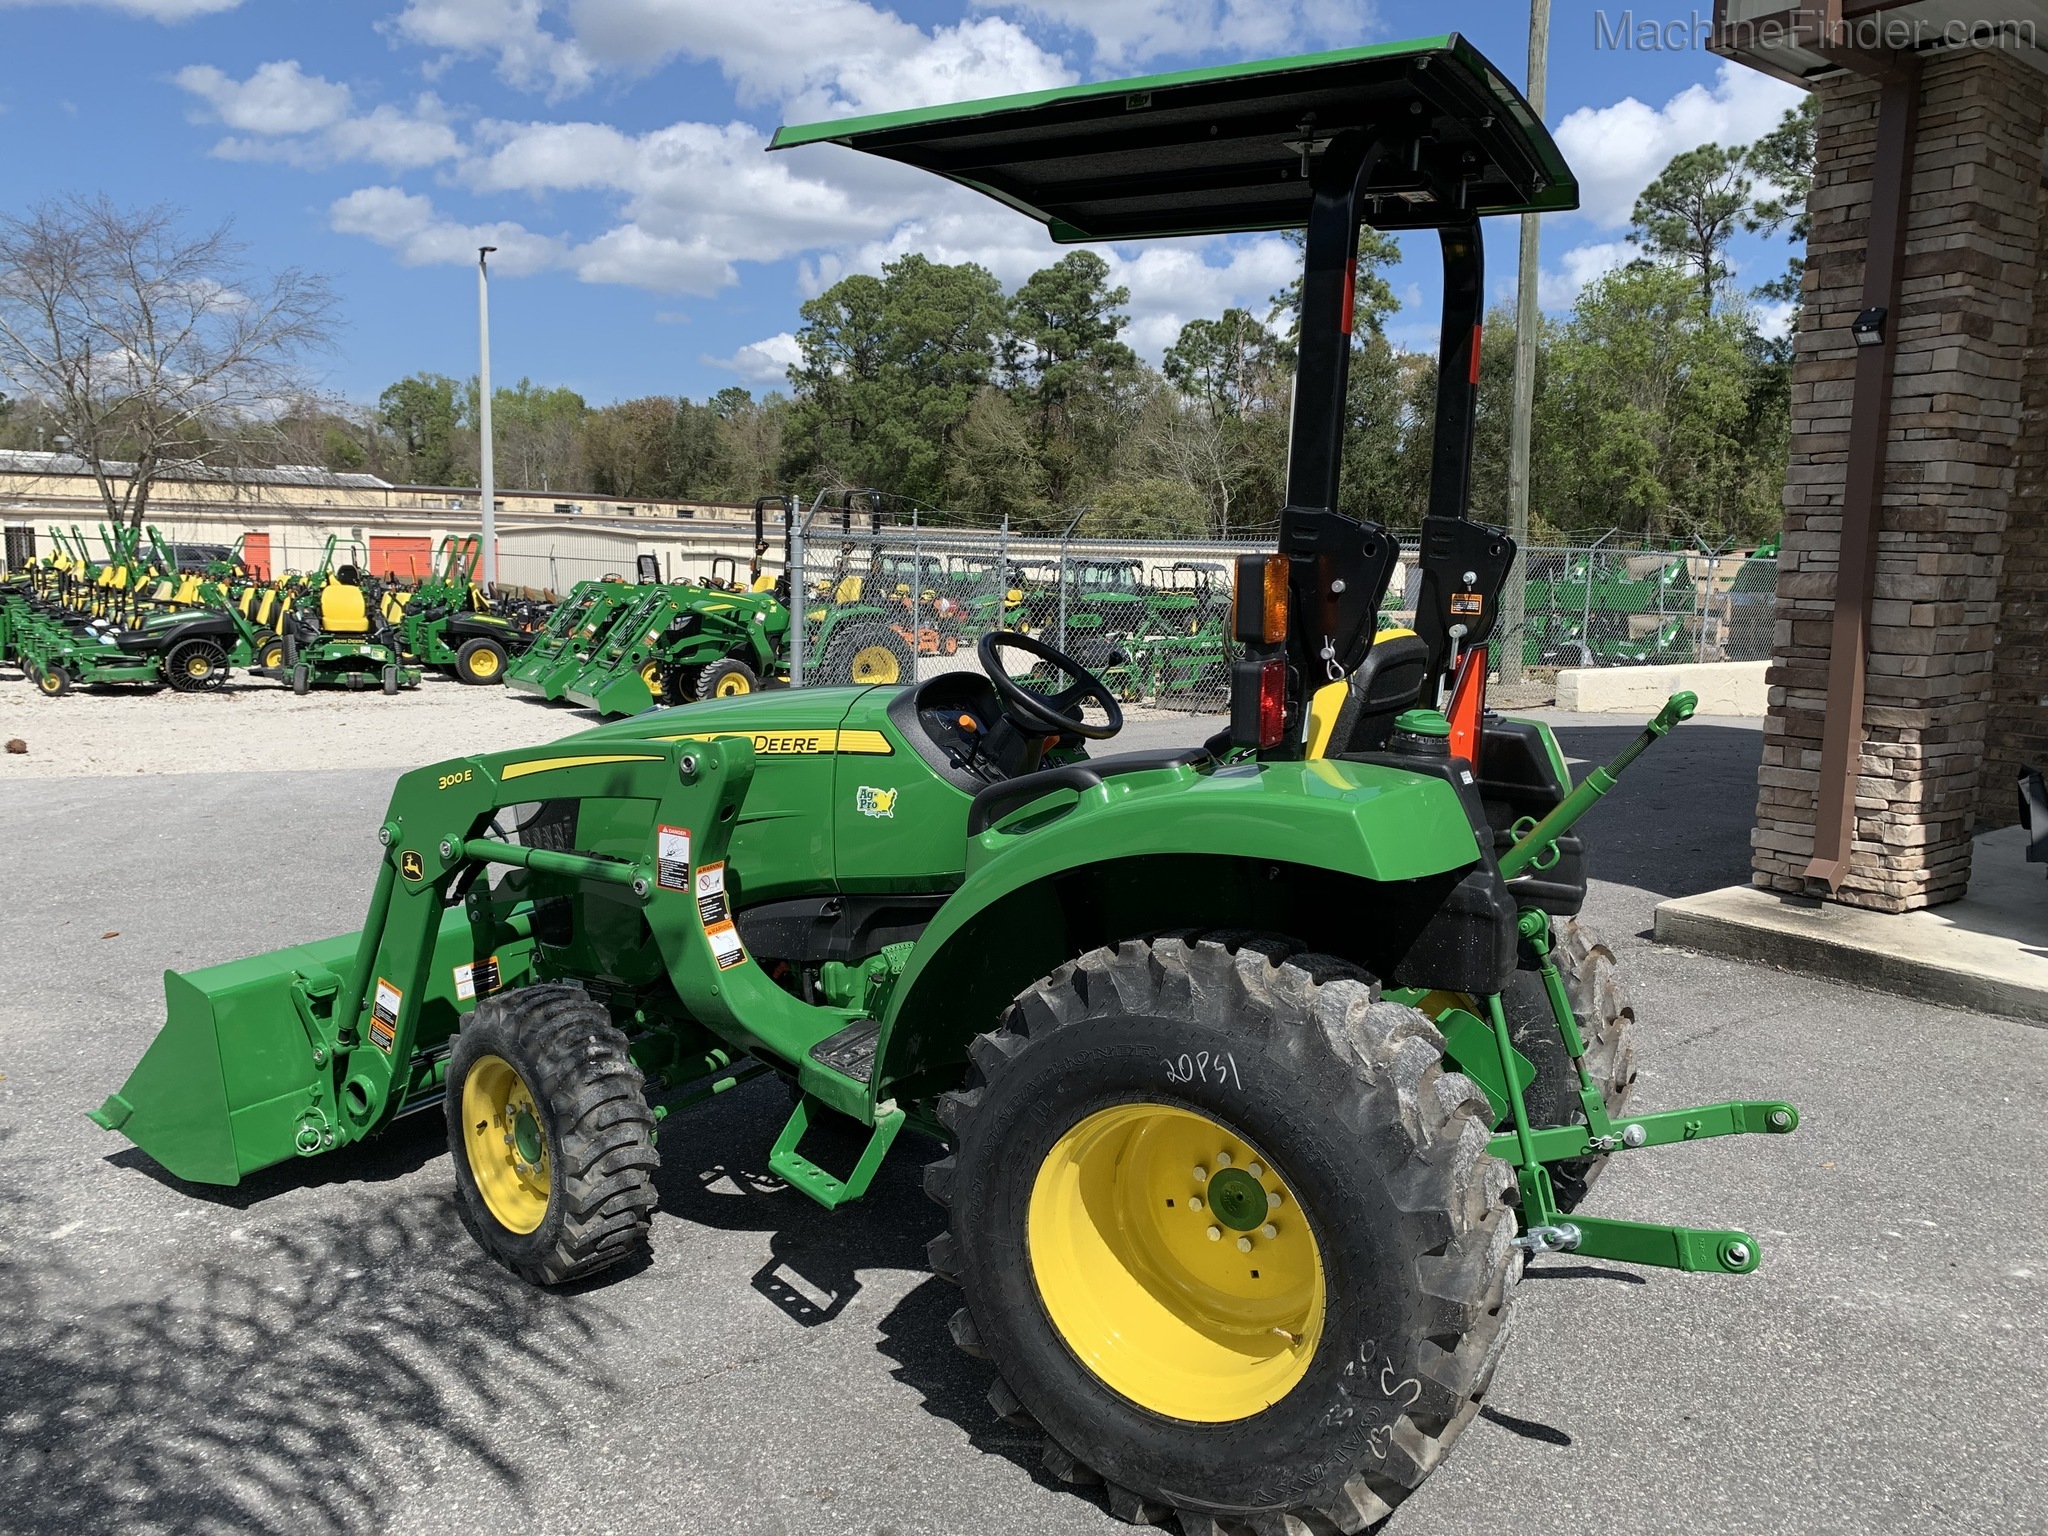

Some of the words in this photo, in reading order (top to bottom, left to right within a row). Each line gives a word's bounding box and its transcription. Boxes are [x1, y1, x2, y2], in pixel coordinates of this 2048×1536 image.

[753, 735, 819, 751] DEERE
[859, 798, 878, 809] Pro
[668, 828, 687, 837] DANGER
[702, 861, 723, 873] WARNING
